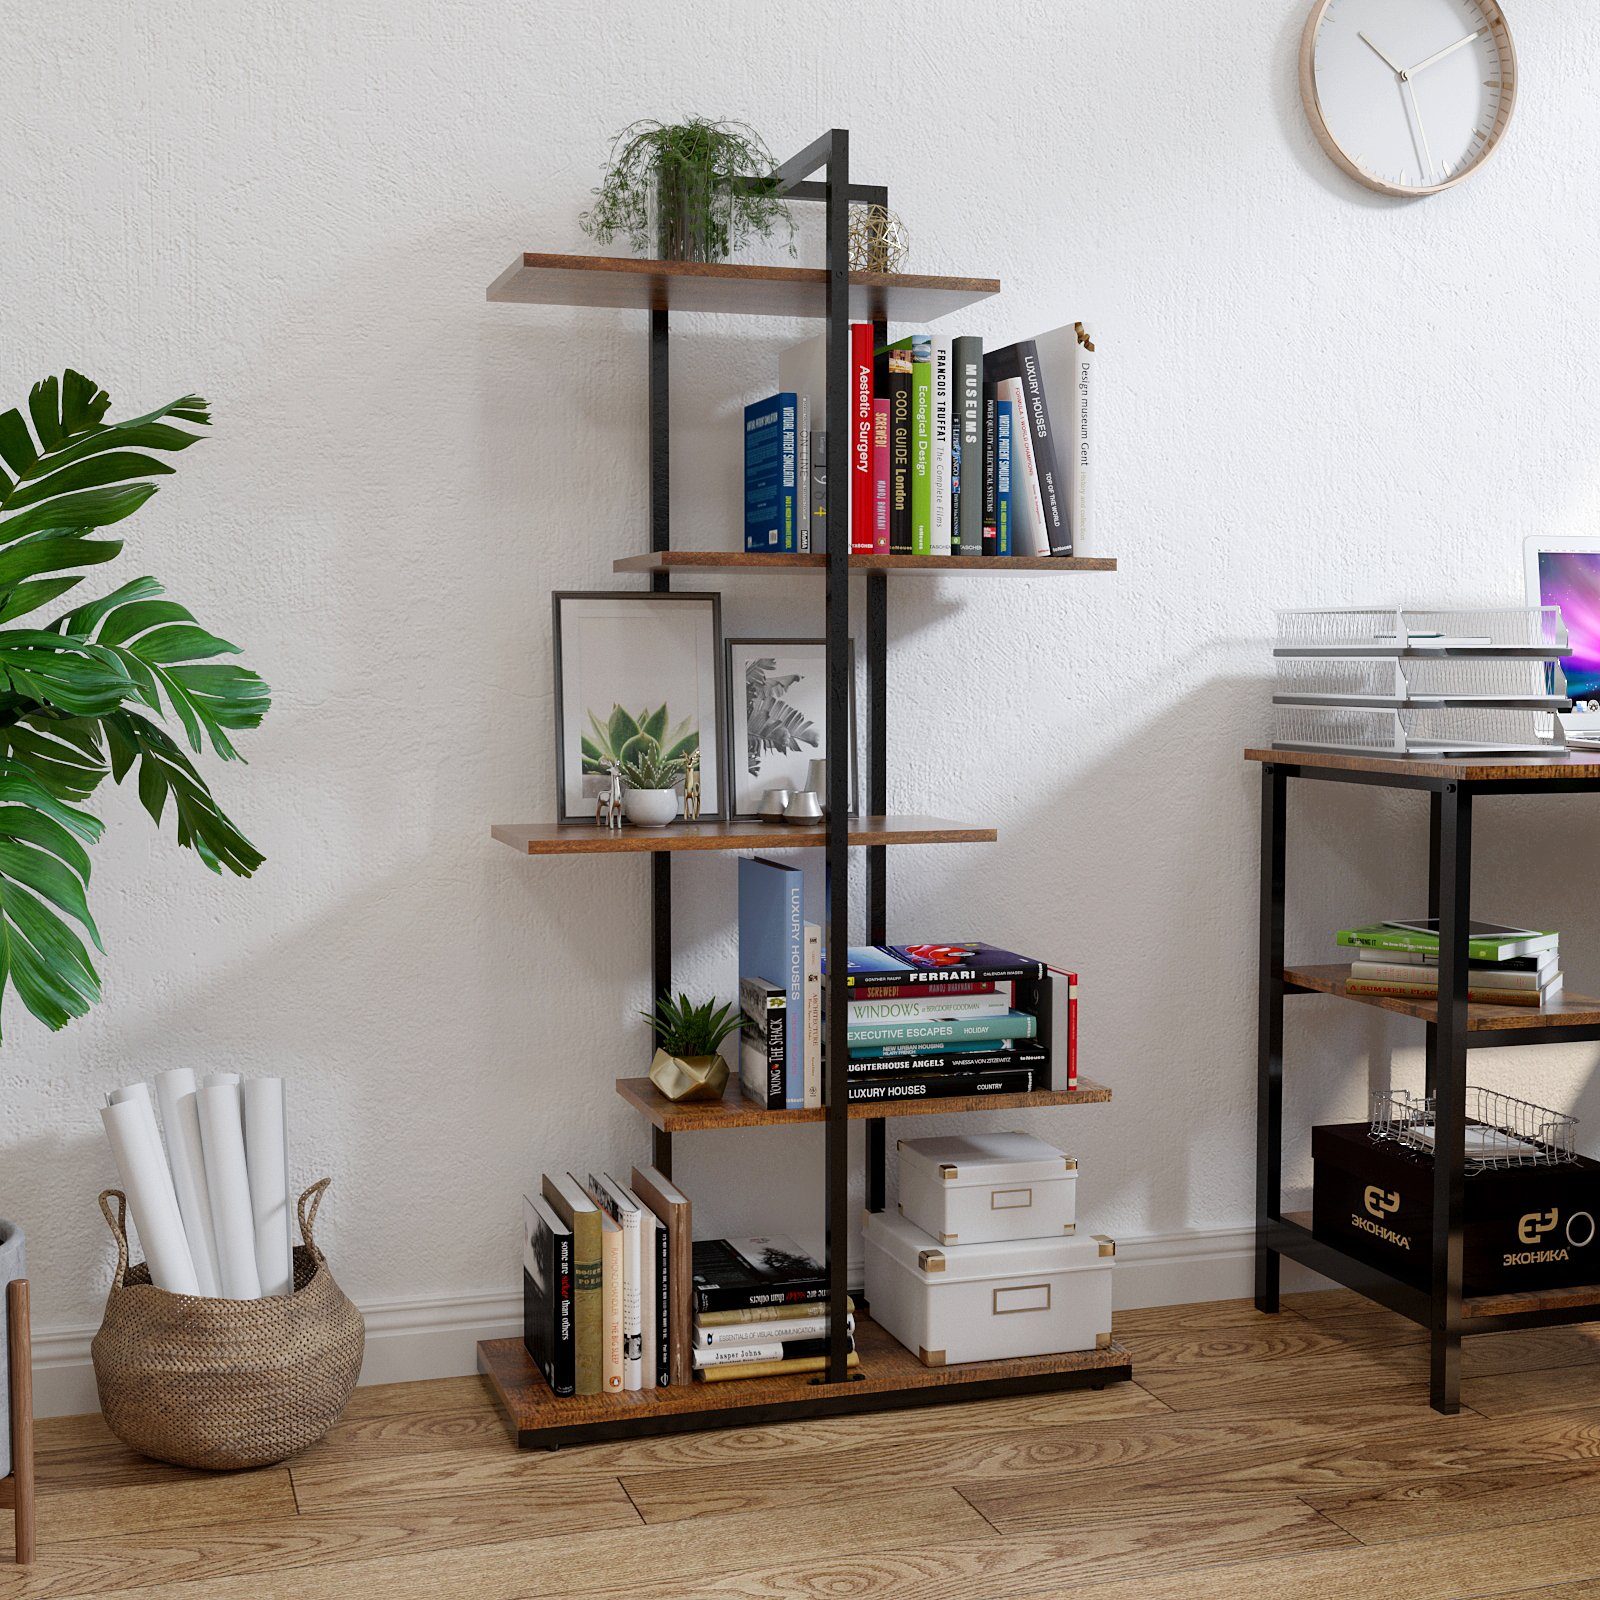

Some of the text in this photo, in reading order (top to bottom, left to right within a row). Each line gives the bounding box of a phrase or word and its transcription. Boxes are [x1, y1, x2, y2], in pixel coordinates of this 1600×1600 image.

[1079, 362, 1090, 396] Design
[965, 364, 977, 444] MUSEUMS
[986, 400, 994, 419] POWER
[782, 407, 794, 431] VIRTUAL
[857, 365, 870, 473] Aestetic Surgery
[875, 412, 888, 448] SCREWED!
[916, 385, 928, 476] Ecological Design
[998, 414, 1010, 438] VIRTUAL
[1081, 398, 1090, 439] museum
[783, 431, 794, 455] PATIENT
[935, 349, 946, 528] FRANCOIS TRUFFAT The Complete Films
[986, 419, 994, 444] QUALITY
[1024, 356, 1061, 527] LUXURY HOUSES TOP OF THE WORLD
[895, 390, 907, 511] COOL GUIDE London
[998, 438, 1010, 461] PATIENT
[1080, 442, 1090, 466] Gent
[783, 454, 795, 487] SIMULATION
[986, 450, 994, 485] ELECTRICAL
[998, 461, 1010, 493] SIMULATION
[877, 480, 887, 500] MANOJ
[986, 486, 994, 513] SYSTEMS
[791, 888, 800, 941] LUXURY
[791, 945, 800, 1001] HOUSES
[909, 971, 976, 982] FERRARI
[867, 986, 899, 998] SCREWED!
[1360, 985, 1406, 994] SUMMER
[854, 1003, 920, 1019] WINDOWS
[847, 1026, 989, 1041] EXECUTIVE ESCAPES HOLIDAY
[769, 1018, 784, 1096] YOUNG THE SHACK
[847, 1061, 910, 1072] UGHTERHOUSE
[912, 1059, 945, 1068] ANGELS
[848, 1083, 1003, 1099] LUXURY HOUSES COUNTRY
[1351, 1213, 1410, 1251] ЭКОНИКА
[561, 1241, 569, 1261] some
[1503, 1249, 1570, 1267] ЭКОНИКА
[561, 1262, 569, 1275] are
[562, 1299, 571, 1317] than
[611, 1248, 619, 1365] RAYMOND CHANDLER THE BIG SLEEP
[749, 1295, 770, 1305] others
[771, 1293, 785, 1303] than
[562, 1317, 572, 1341] others
[718, 1333, 749, 1342] ESSENTIALS
[774, 1327, 817, 1336] COMMUNICATION
[715, 1352, 739, 1360] Jasper
